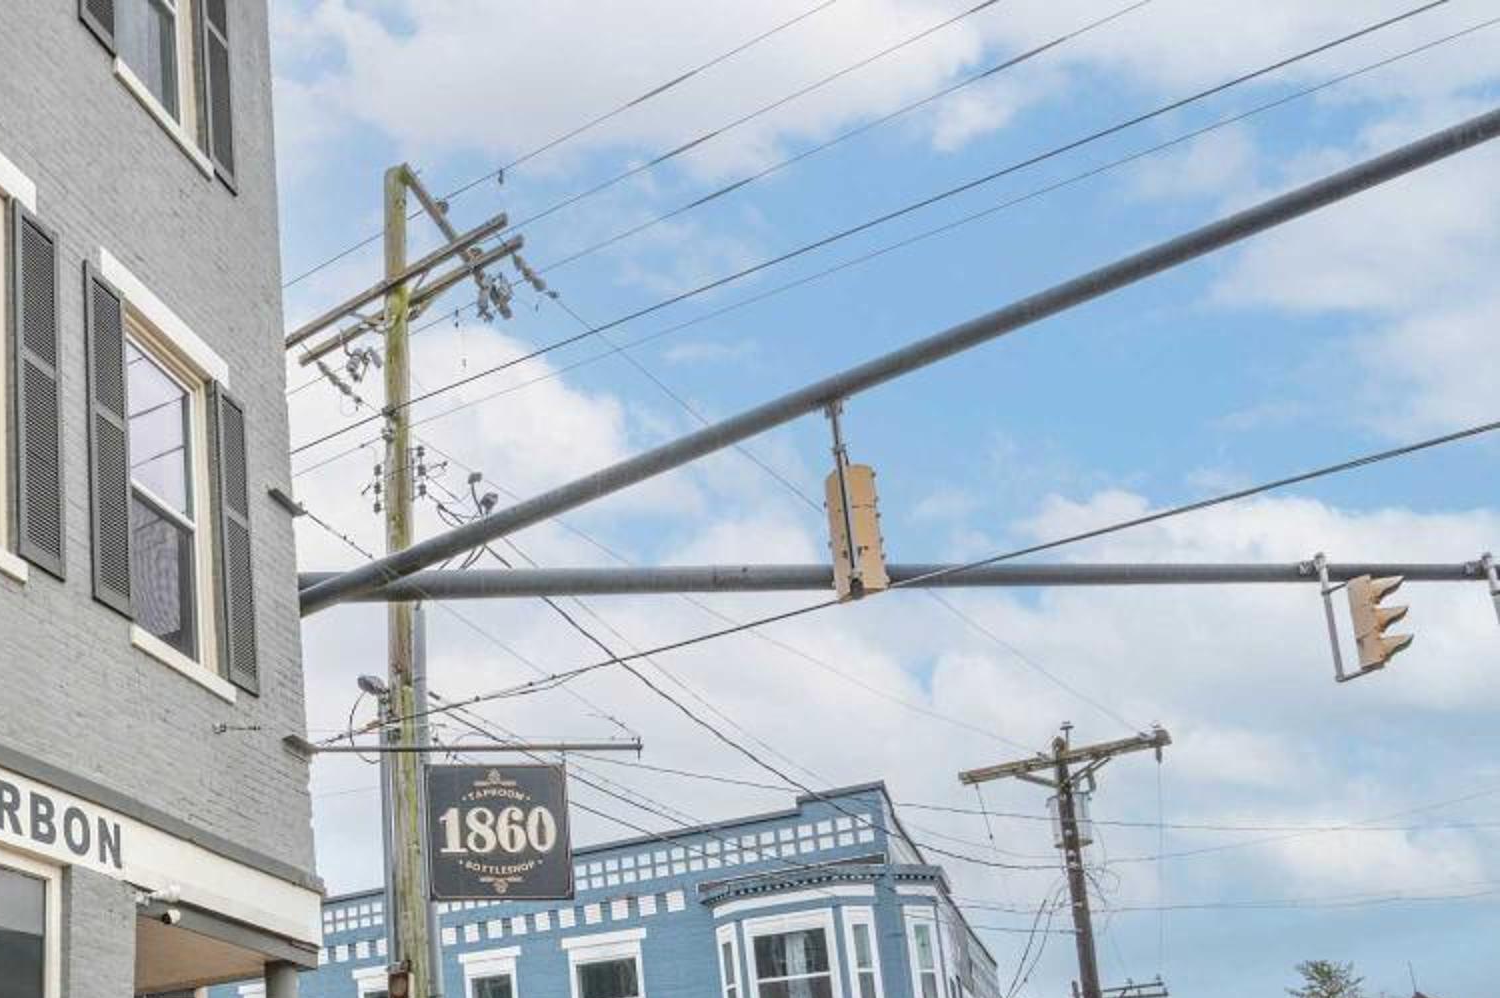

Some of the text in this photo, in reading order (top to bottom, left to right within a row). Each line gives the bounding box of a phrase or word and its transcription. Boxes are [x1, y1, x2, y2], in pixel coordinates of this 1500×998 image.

[467, 788, 524, 800] TAPROOM
[439, 806, 557, 853] 1860
[465, 860, 535, 875] BOTTLESHOP
